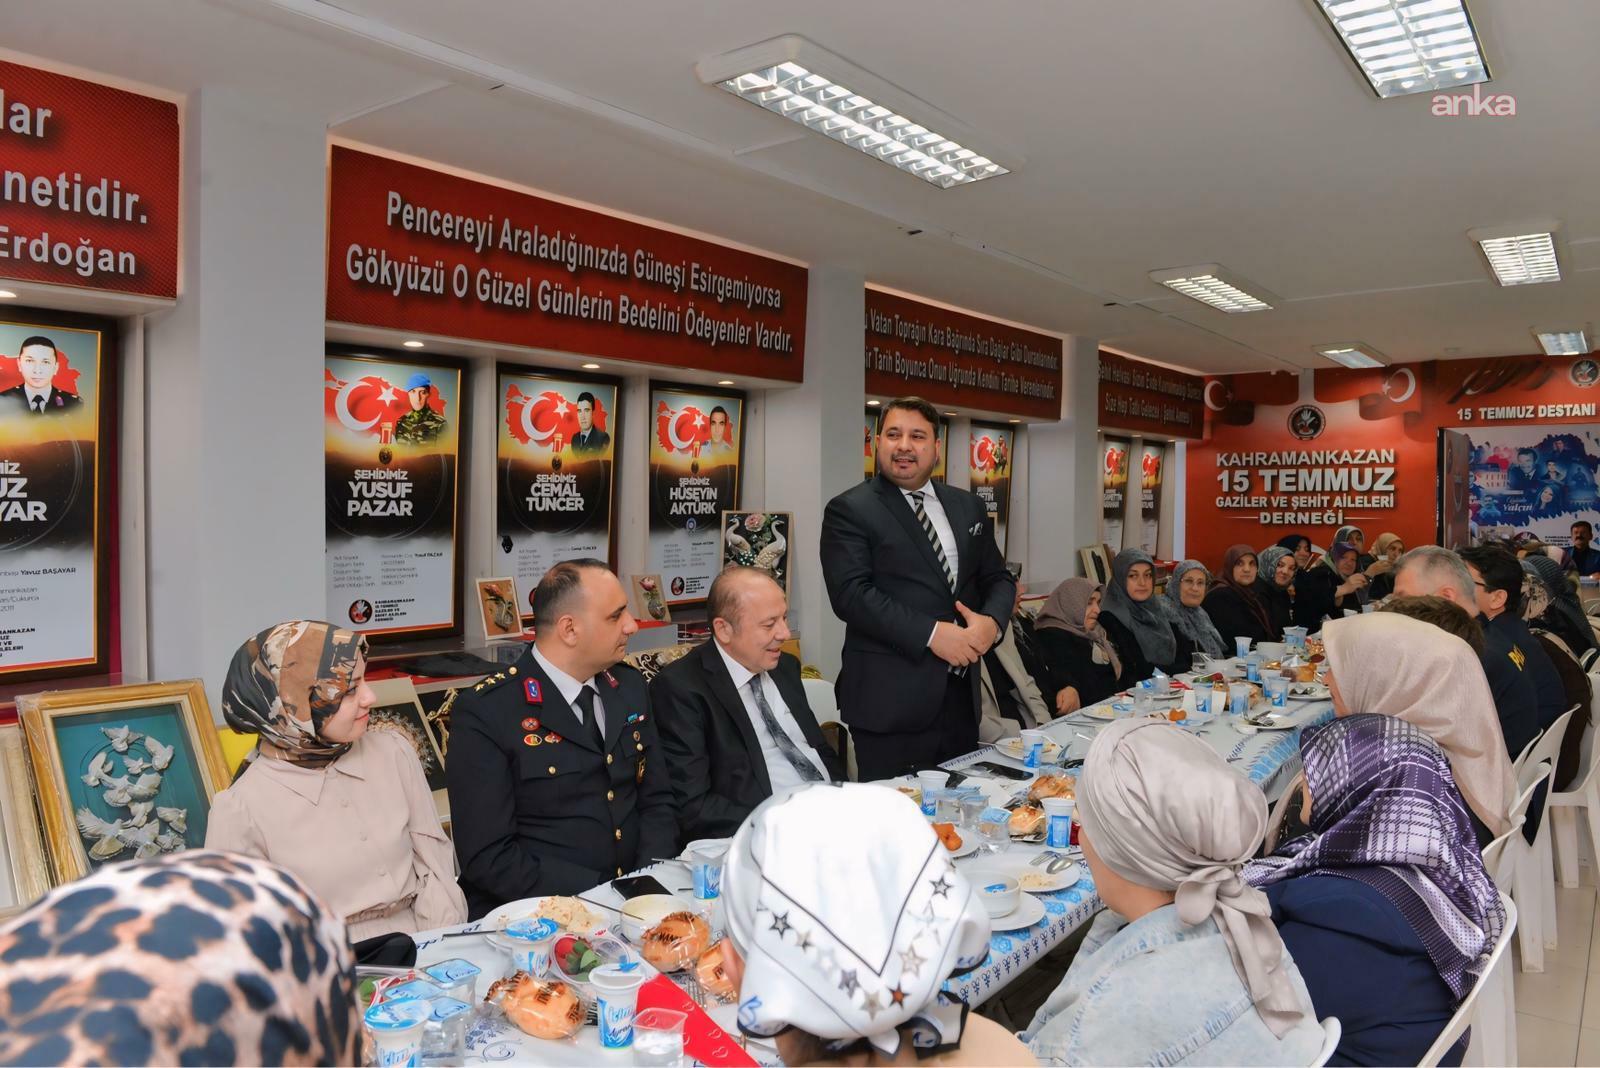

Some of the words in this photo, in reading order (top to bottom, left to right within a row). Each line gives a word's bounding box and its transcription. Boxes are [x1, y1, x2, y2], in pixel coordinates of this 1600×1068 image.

[4, 169, 147, 224] netidir.
[0, 226, 136, 277] Erdoğan
[387, 191, 493, 253] Pencereyi
[499, 218, 627, 275] Araladığınızda
[633, 249, 686, 293] Güneşi
[691, 262, 781, 309] Esirgemiyorsa
[346, 244, 444, 296] Gökyüzü
[453, 264, 468, 298] O
[476, 268, 530, 308] Güzel
[538, 280, 612, 322] Günlerin
[619, 295, 680, 333] Bedelini
[685, 302, 751, 346] Ödeyenler
[755, 321, 793, 352] Vardır.
[871, 308, 892, 335] Vatan
[895, 314, 926, 346] Toprağın
[929, 322, 945, 346] Kara
[946, 326, 976, 354] Bağrında
[873, 347, 892, 372] Tarih
[895, 351, 927, 380] Boyunca
[928, 358, 947, 381] Onun
[948, 361, 976, 388] Uğrunda
[1457, 408, 1472, 420] 15
[1478, 405, 1535, 420] TEMMUZ
[1538, 403, 1596, 418] DESTANI
[1216, 449, 1395, 467] KAHRAMANKAZAN
[354, 467, 408, 481] ŞEHİDİMİZ
[536, 472, 577, 483] ŞEHİDİMİZ
[1217, 469, 1250, 493] 15
[1258, 467, 1395, 492] TEMMUZ
[348, 481, 413, 498] YUSUF
[530, 483, 581, 497] CEMAL
[347, 500, 413, 517] PAZAR
[526, 497, 585, 512] TUNCER
[669, 499, 717, 515] AKTÜRK
[1216, 494, 1268, 508] GAZİLER
[1271, 495, 1288, 508] VE
[1291, 493, 1330, 511] ŞEHİT
[1333, 493, 1394, 508] AİLELERİ
[1260, 509, 1344, 525] DERNEĞİ
